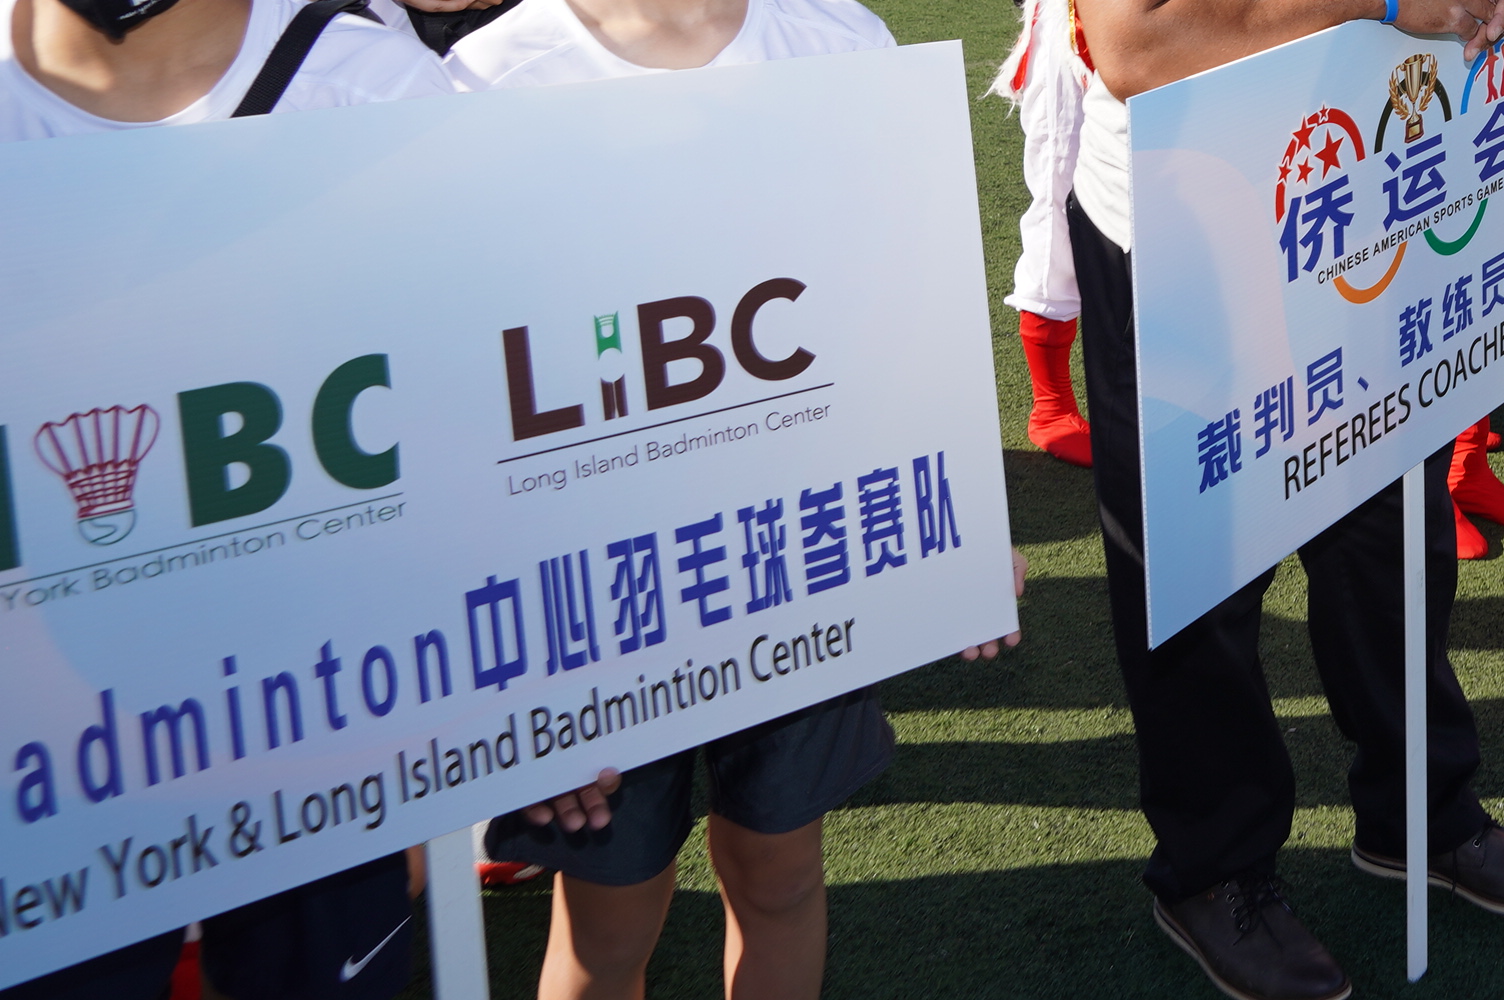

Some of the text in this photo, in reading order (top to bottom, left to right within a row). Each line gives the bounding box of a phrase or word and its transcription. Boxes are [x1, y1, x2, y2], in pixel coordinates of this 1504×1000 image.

[1318, 177, 1504, 284] CHINESE AMERICAN SPORTS GAME
[508, 404, 832, 496] Long Island Badminton Center
[1284, 383, 1411, 501] REFEREES
[91, 529, 285, 593] Badminton
[296, 502, 406, 542] Center
[98, 814, 219, 899] York
[228, 801, 265, 858] &
[273, 771, 387, 845] Long
[399, 715, 517, 804] Island
[528, 655, 742, 759] Badmintion
[749, 618, 855, 682] Center
